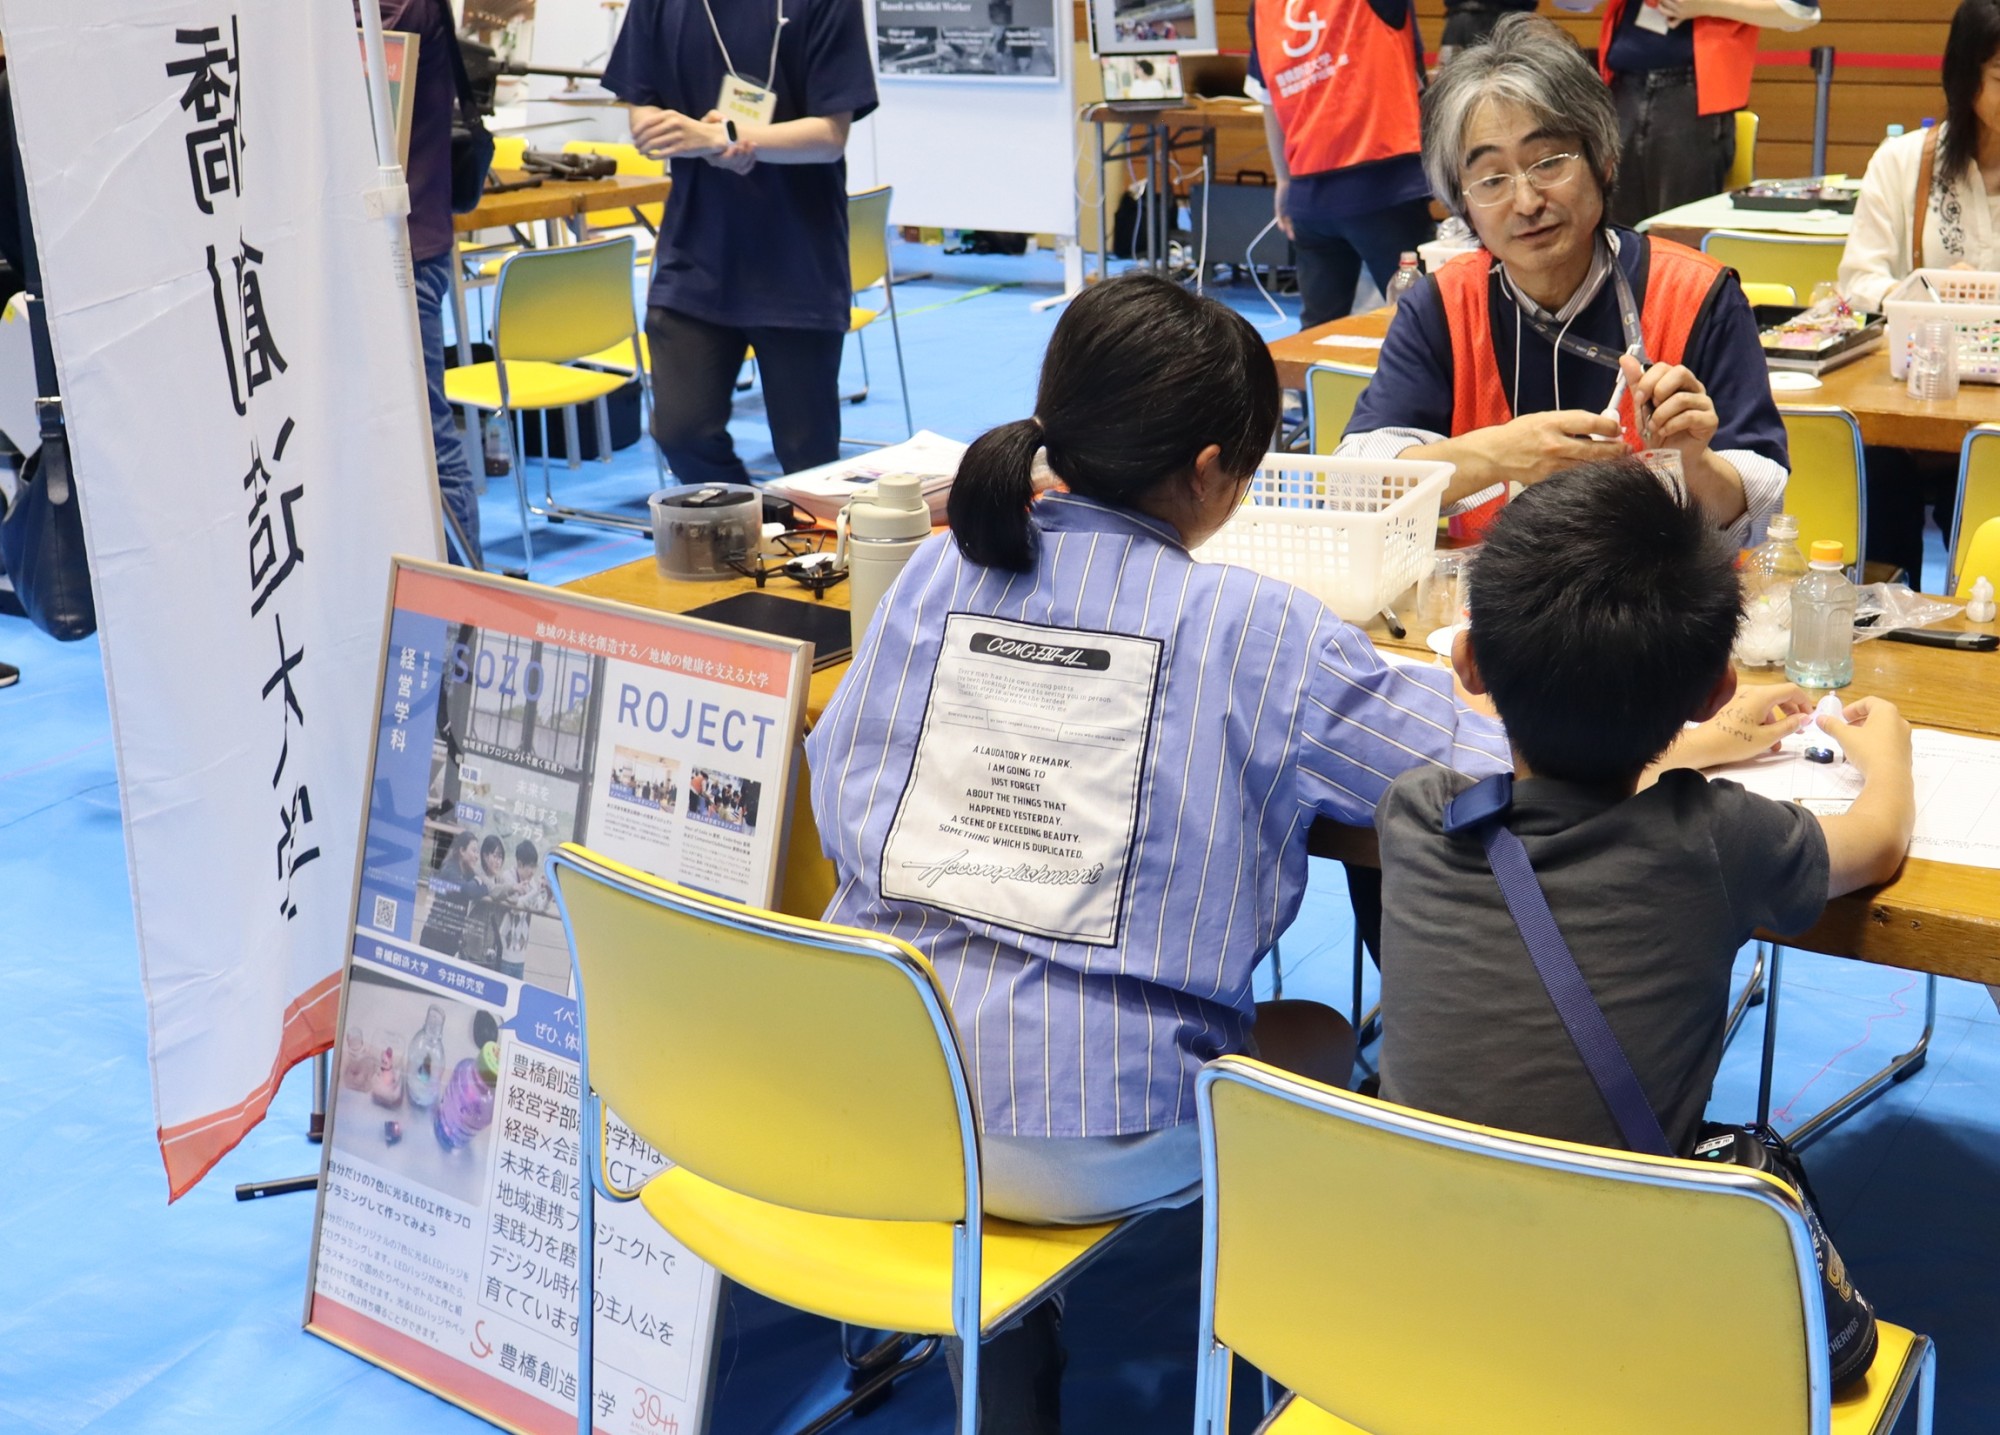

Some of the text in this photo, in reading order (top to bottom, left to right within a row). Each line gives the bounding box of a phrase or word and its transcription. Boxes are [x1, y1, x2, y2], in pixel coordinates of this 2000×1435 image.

[451, 643, 544, 702] SOZO
[390, 646, 416, 753] 経営学科
[980, 746, 1026, 762] LAUDATORY
[1030, 754, 1072, 769] REMARK.
[988, 763, 1046, 779] I AM GOING TO
[991, 778, 1040, 792] JUST FORGET
[456, 804, 483, 822] 行動力
[514, 800, 558, 825] 創造する
[966, 788, 1067, 812] ABOUT THE THINGS THAT
[969, 803, 1063, 826] HAPPENED YESTERDAY.
[512, 822, 544, 840] チカラ
[938, 824, 1084, 859] SOMETHING WHICH IS DUPLICATED.
[960, 816, 985, 828] SCENE
[986, 820, 997, 829] OF
[999, 822, 1041, 838] EXCEEDING
[1043, 830, 1081, 844] BEAUTY.
[901, 848, 1104, 888] Accomplishment
[438, 968, 486, 995] 今井研究室
[534, 1022, 580, 1052] ぜひ、体
[498, 1343, 616, 1417] 豊橋創造学
